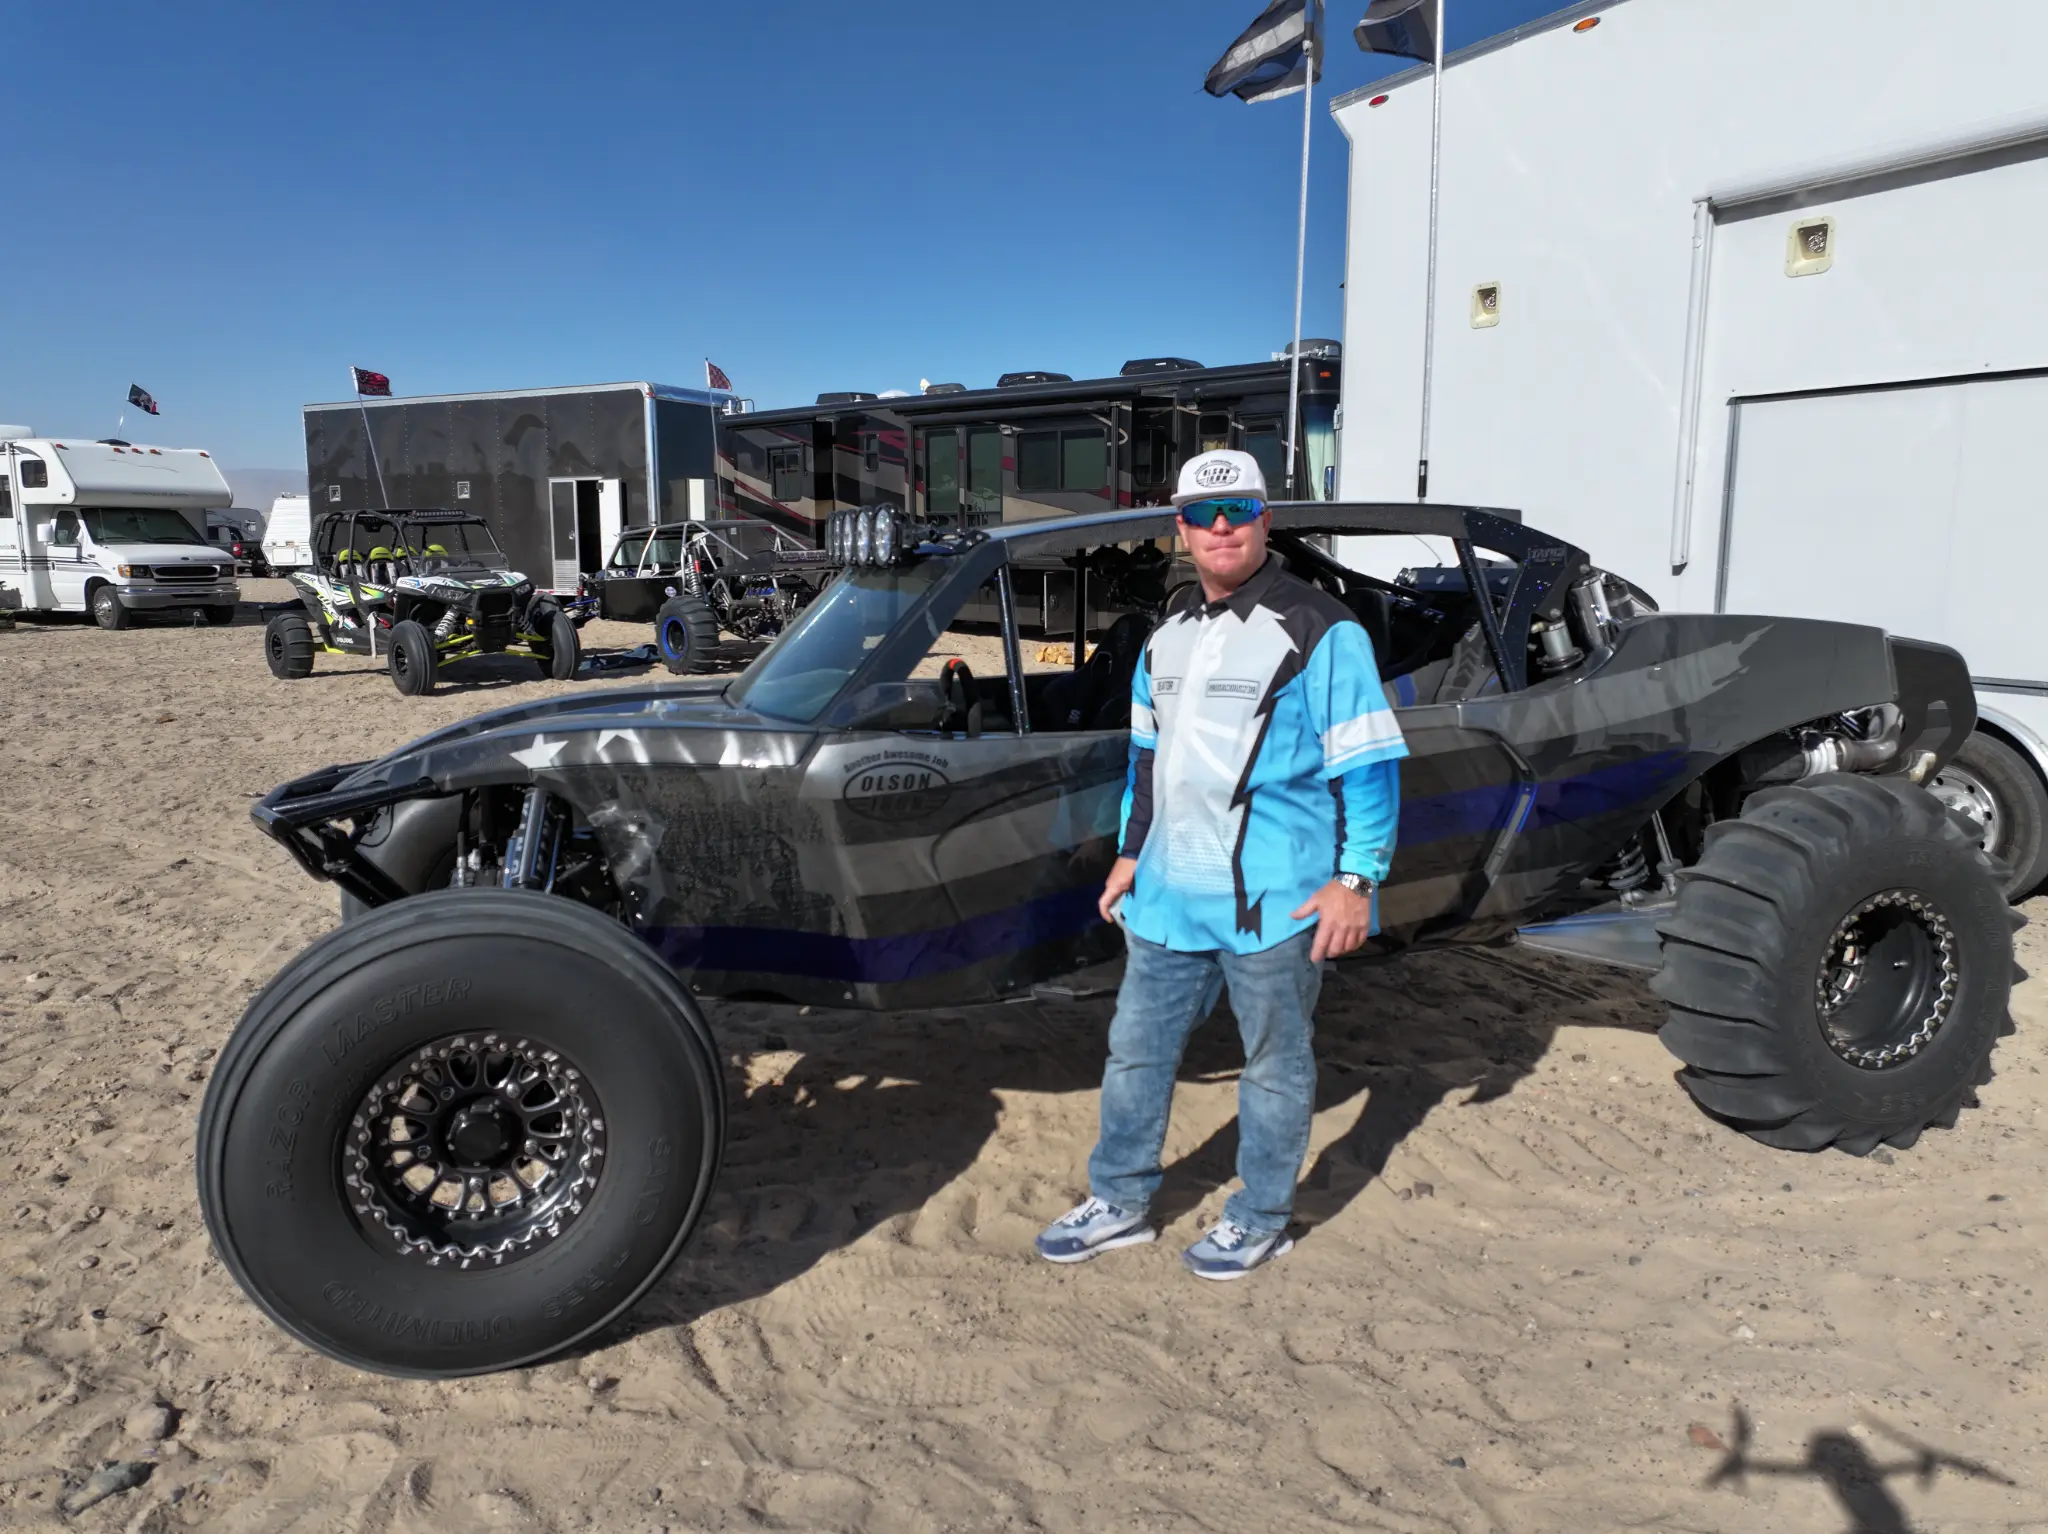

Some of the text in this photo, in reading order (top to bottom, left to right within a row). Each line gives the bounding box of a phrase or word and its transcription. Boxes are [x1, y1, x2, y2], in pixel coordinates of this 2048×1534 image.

[883, 750, 930, 762] Awesome
[861, 773, 931, 792] OLSON
[419, 1034, 581, 1079] RACING
[264, 1078, 315, 1200] RAZOR
[320, 976, 472, 1066] MASTER
